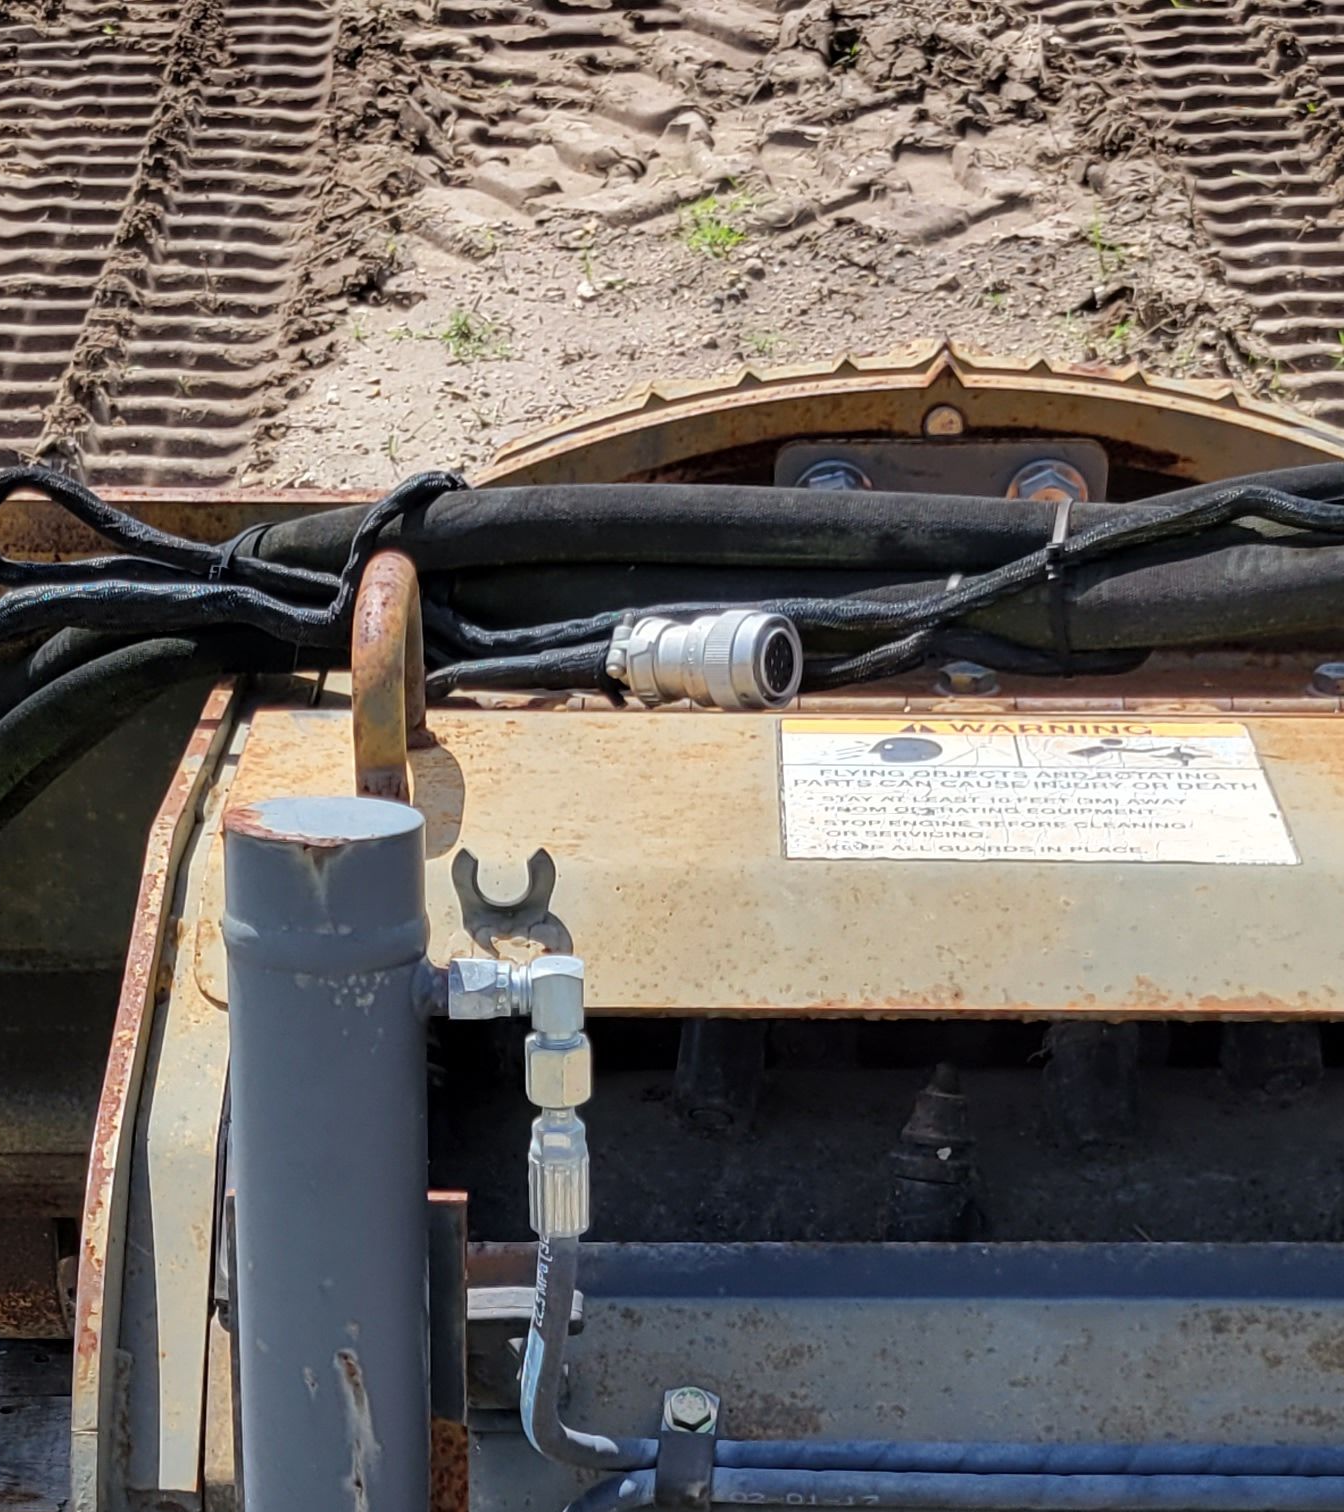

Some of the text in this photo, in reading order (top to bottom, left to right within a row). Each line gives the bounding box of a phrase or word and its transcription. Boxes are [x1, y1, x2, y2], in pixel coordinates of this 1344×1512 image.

[950, 723, 1152, 735] WARNING
[820, 769, 1221, 781] FLYING OBJECTS AND ROTATING
[793, 779, 1258, 791] PARTS CAN CAUSE INJURY OR DEATH
[822, 795, 873, 803] STAY
[880, 795, 904, 803] AT
[913, 796, 980, 804] LEAST
[990, 796, 1012, 804] 10
[1127, 797, 1188, 806] AWAY
[1027, 807, 1157, 816] EQUIPMENT
[824, 819, 881, 827] STOP
[889, 819, 973, 828] ENGINE
[1074, 821, 1187, 830] CLEANING
[826, 830, 858, 838] OR
[891, 844, 934, 852] ALL
[938, 845, 1034, 853] GUARDS
